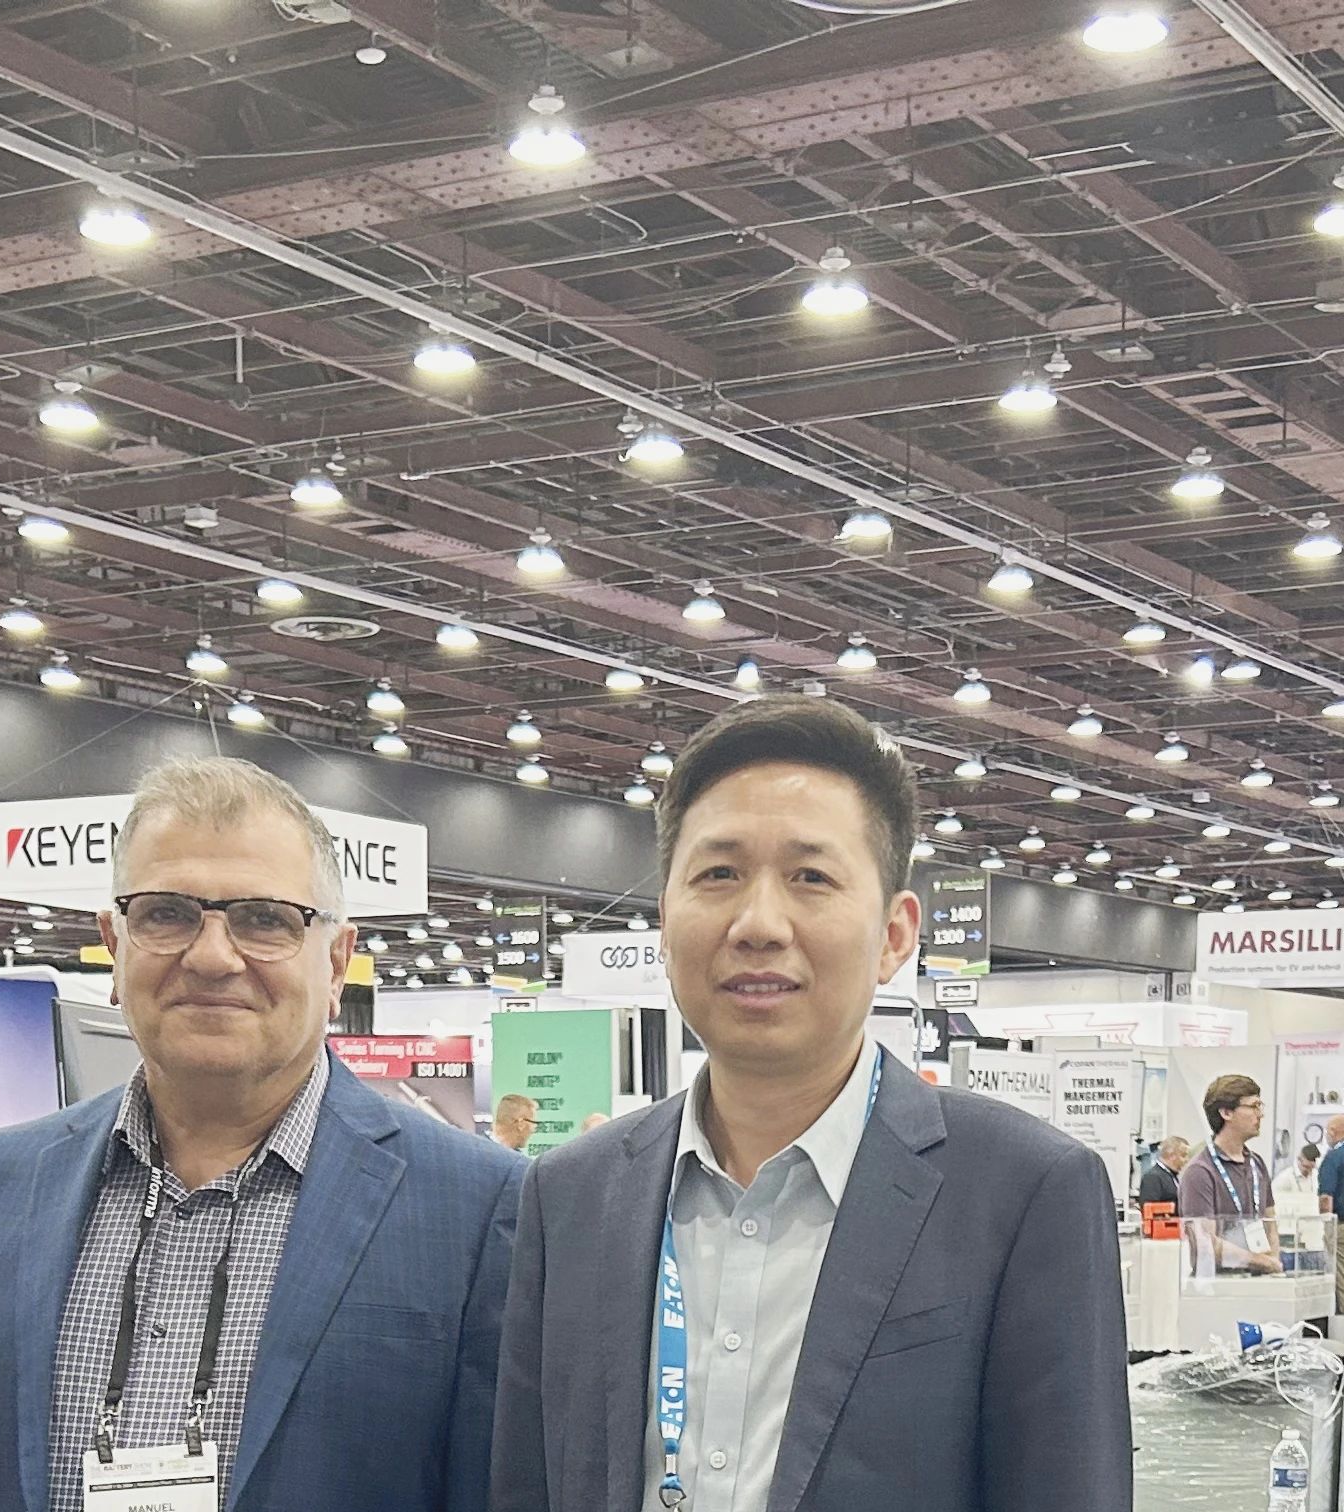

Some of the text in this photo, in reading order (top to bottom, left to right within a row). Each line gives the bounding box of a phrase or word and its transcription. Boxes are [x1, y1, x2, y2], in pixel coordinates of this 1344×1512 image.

[1209, 928, 1342, 954] MARSILLI
[1072, 1077, 1116, 1089] THERMAL
[1066, 1104, 1120, 1115] SOLUTIONS
